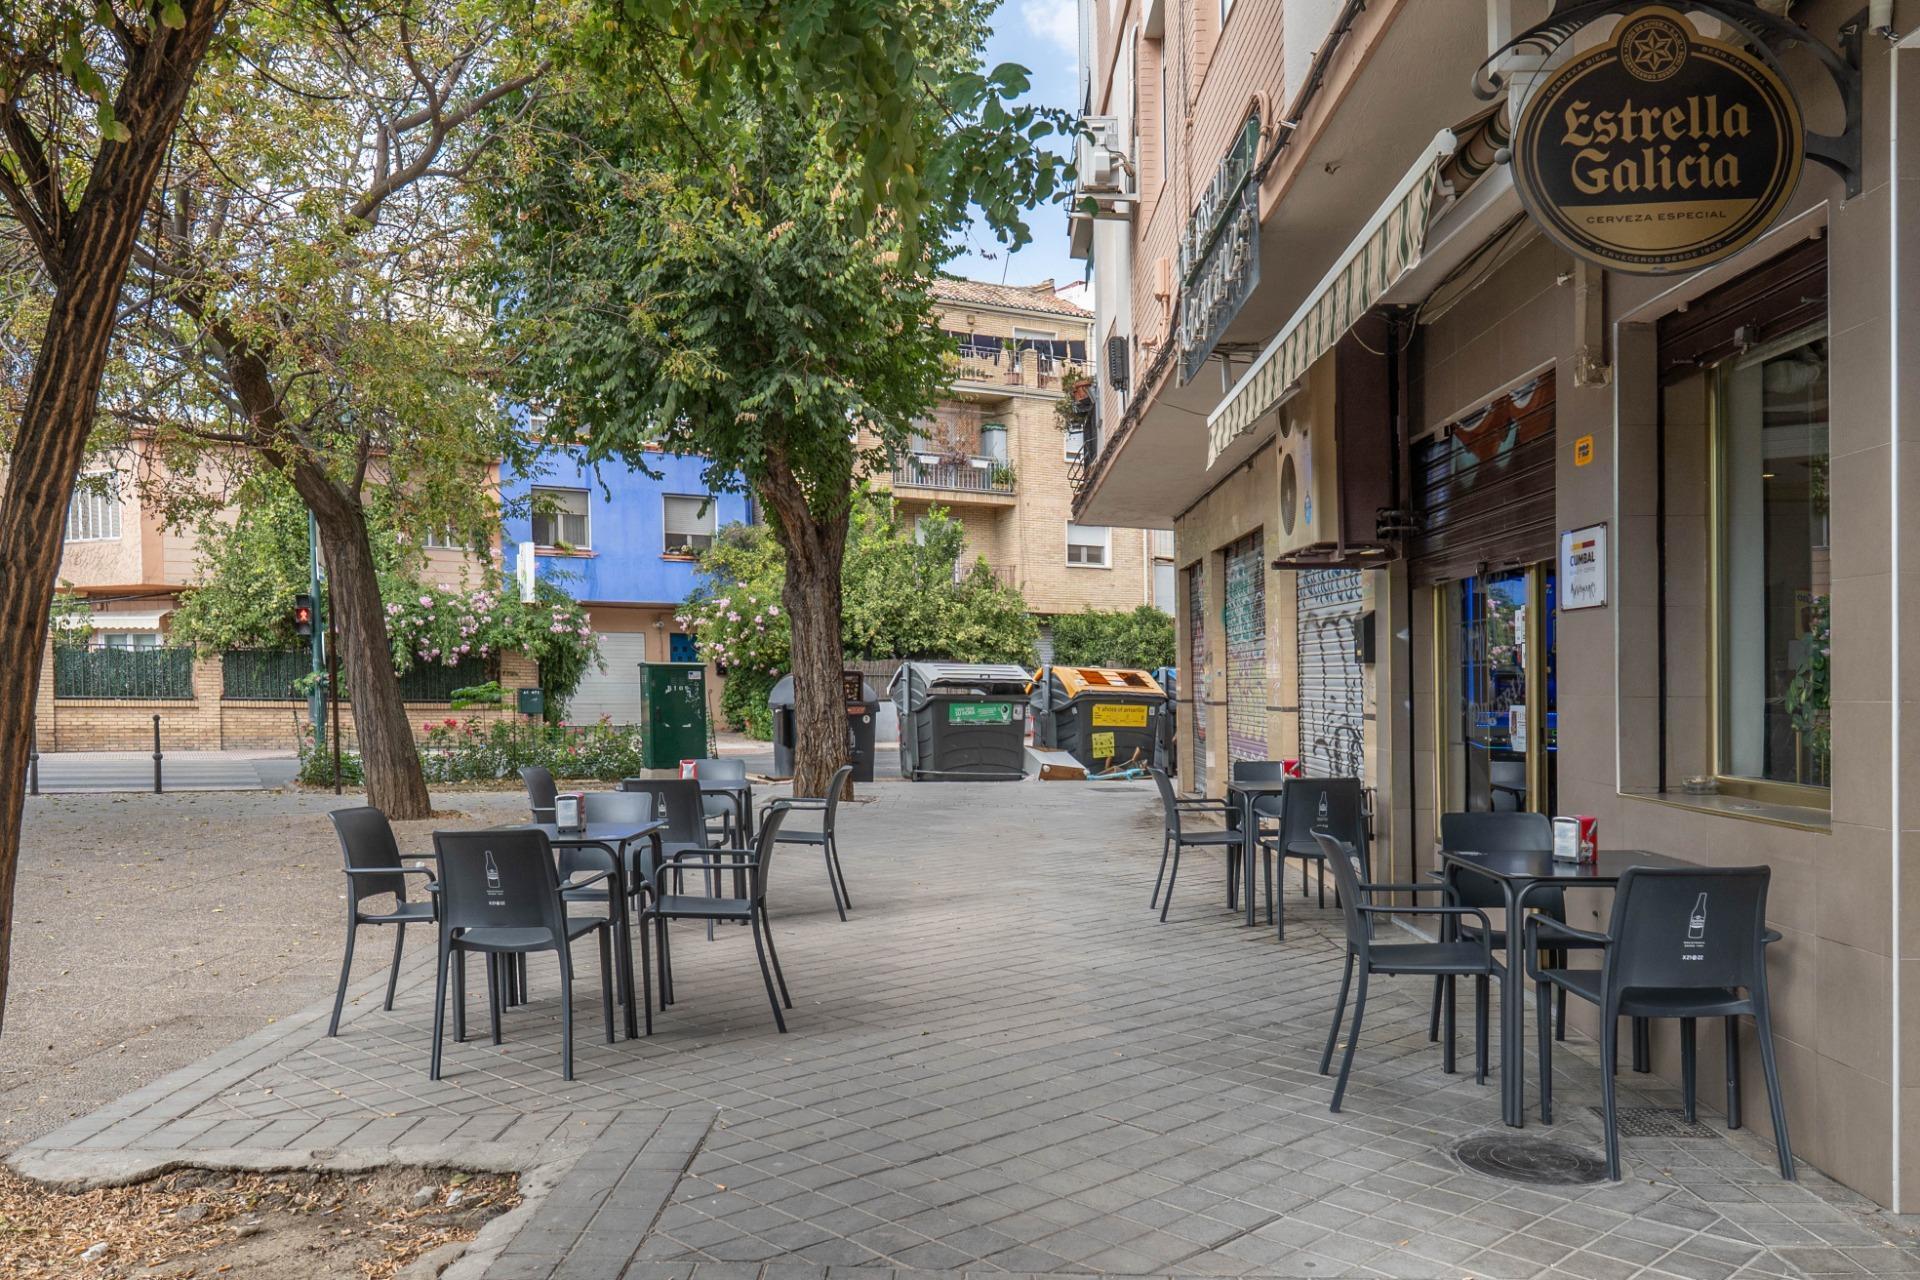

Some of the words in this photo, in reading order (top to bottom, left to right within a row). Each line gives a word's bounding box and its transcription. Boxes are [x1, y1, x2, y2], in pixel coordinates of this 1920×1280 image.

[1561, 94, 1751, 147] Estrella
[1571, 143, 1742, 195] Galicia
[1586, 214, 1654, 225] CERVEZA
[1657, 210, 1727, 222] ESPECIAL
[1594, 246, 1661, 263] CERVECEROS
[1664, 251, 1698, 263] DESDE
[1569, 551, 1596, 567] CUMBAL
